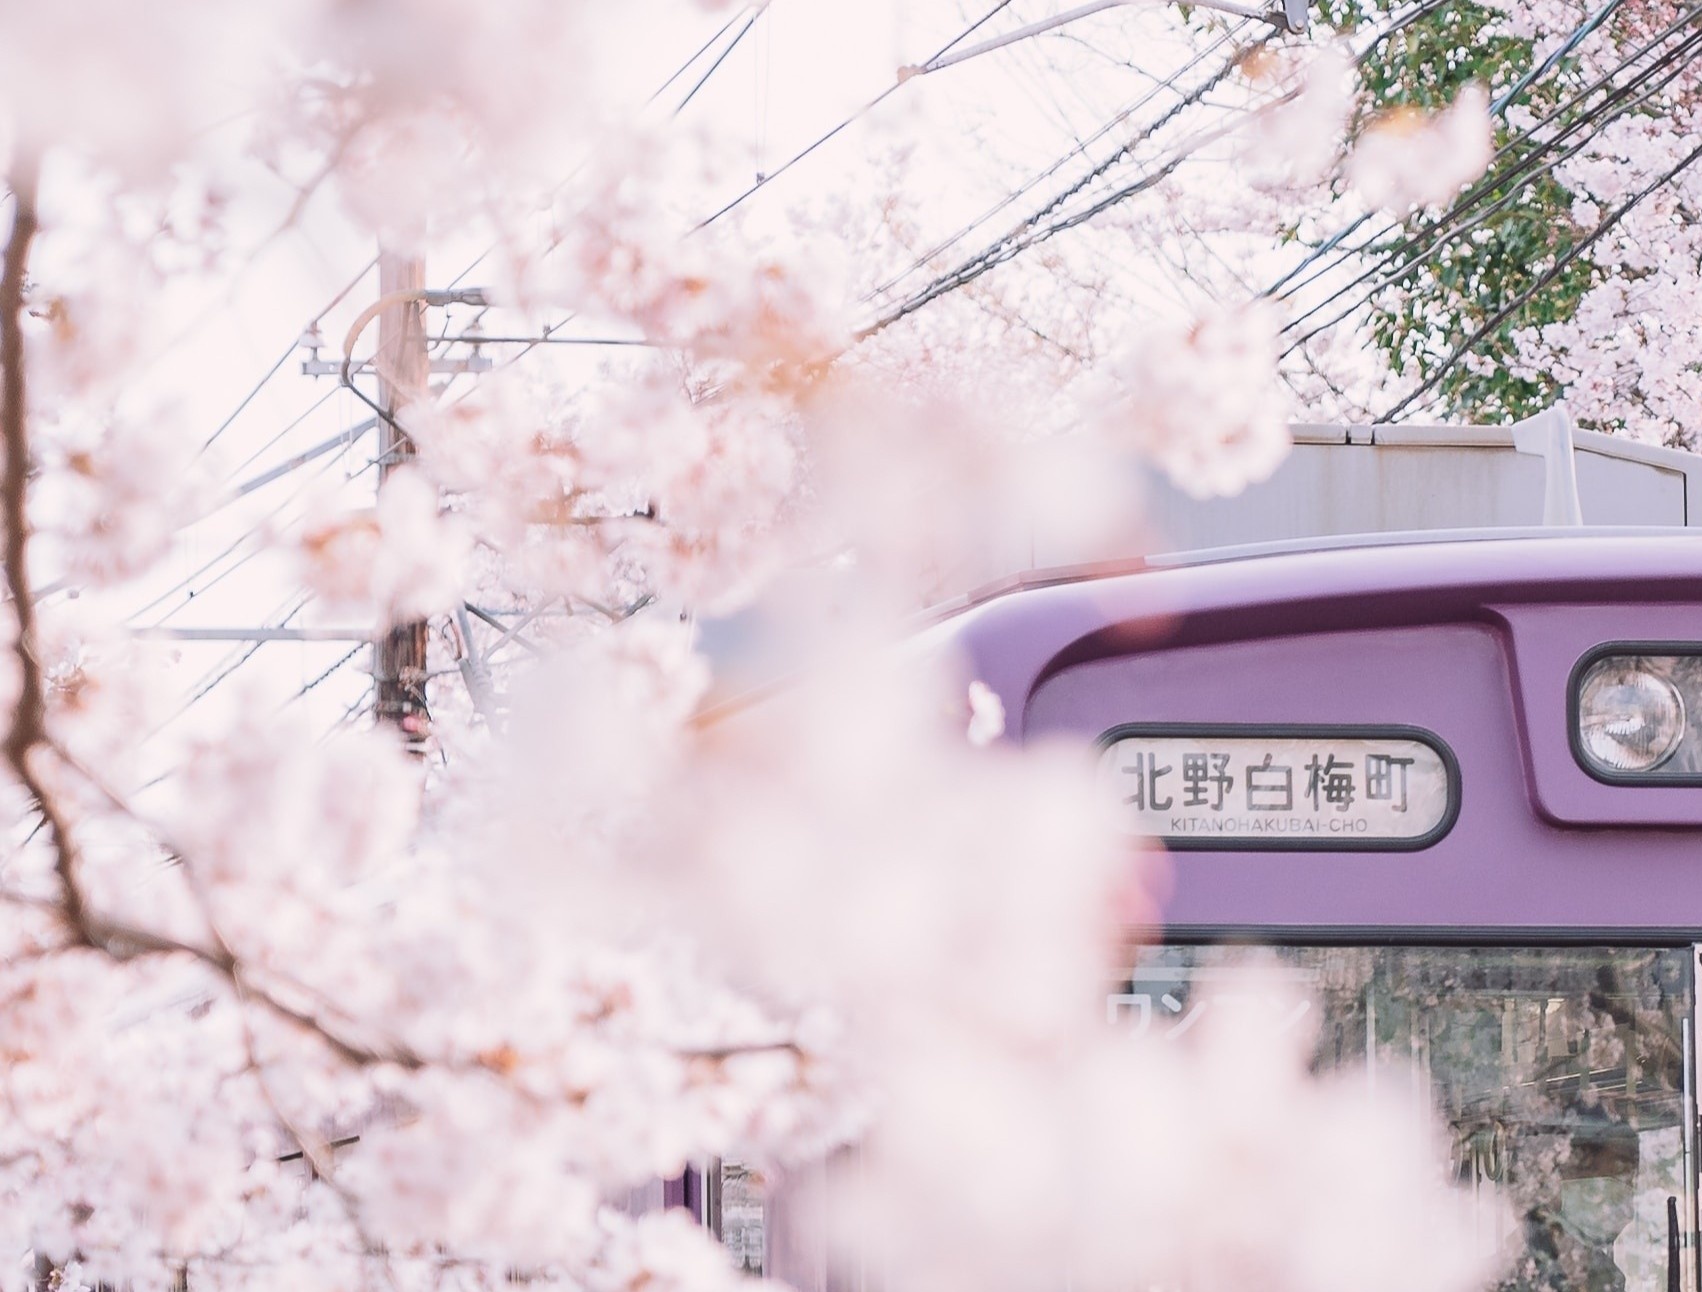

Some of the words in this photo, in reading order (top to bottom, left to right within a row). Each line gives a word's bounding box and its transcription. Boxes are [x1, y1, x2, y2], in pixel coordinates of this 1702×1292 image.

[1120, 751, 1416, 812] 北野白梅町
[1170, 817, 1368, 833] KITANOHAKUBAI-CHO
[1106, 993, 1311, 1040] ワンン
